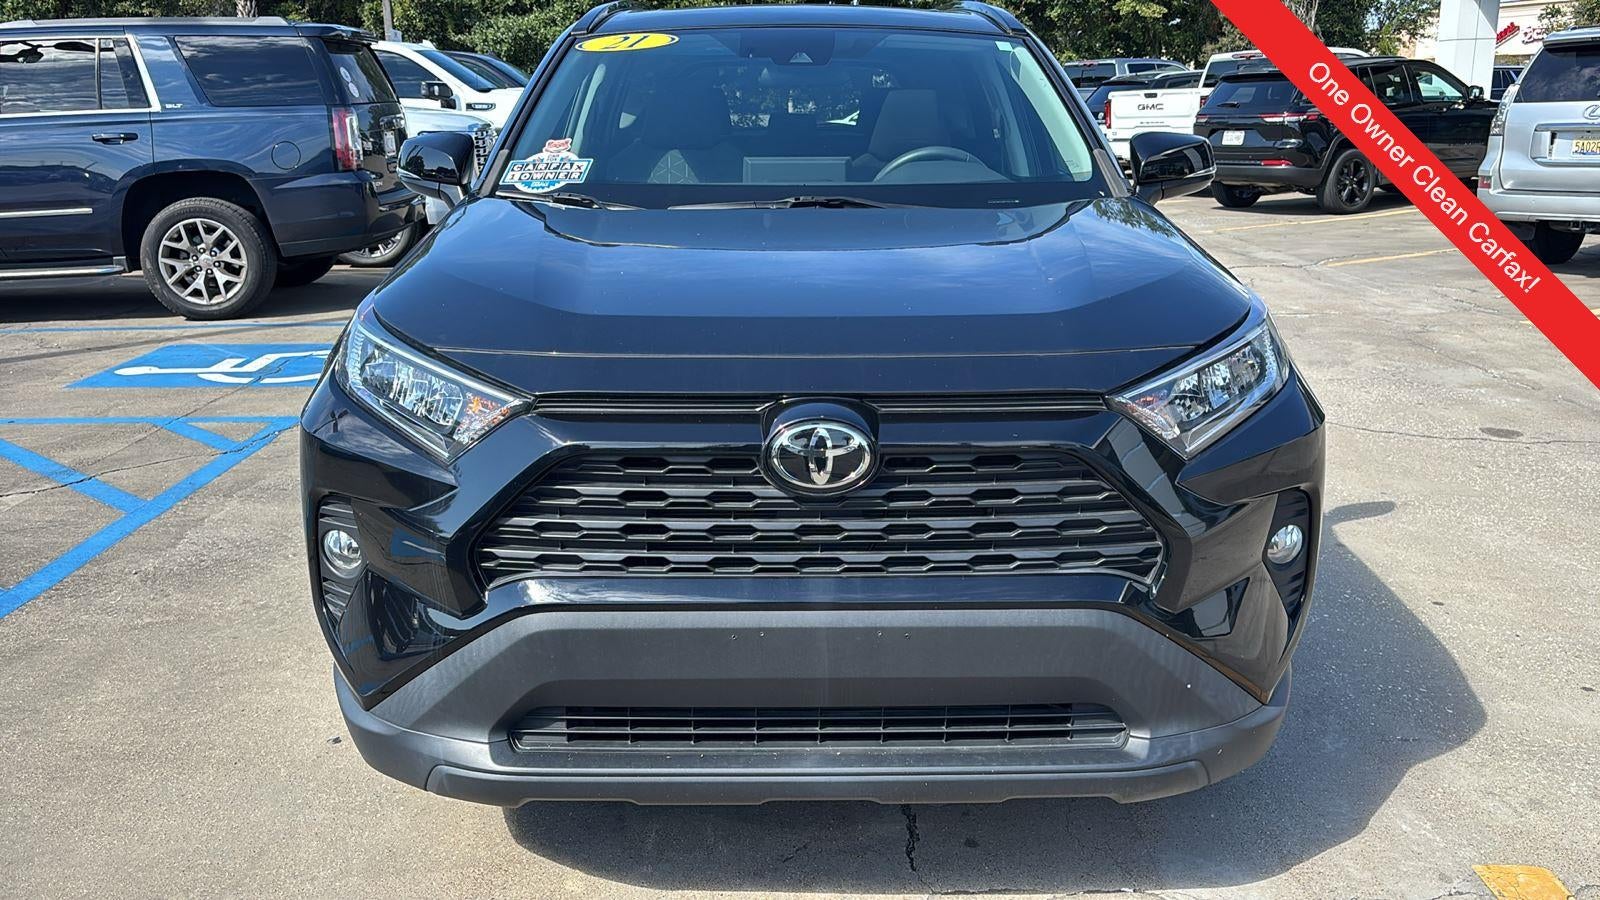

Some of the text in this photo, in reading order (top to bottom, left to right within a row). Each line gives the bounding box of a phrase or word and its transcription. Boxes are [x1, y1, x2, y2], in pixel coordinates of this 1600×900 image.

[599, 35, 649, 49] 21
[511, 162, 584, 172] CARFAX
[520, 172, 581, 180] OWNER
